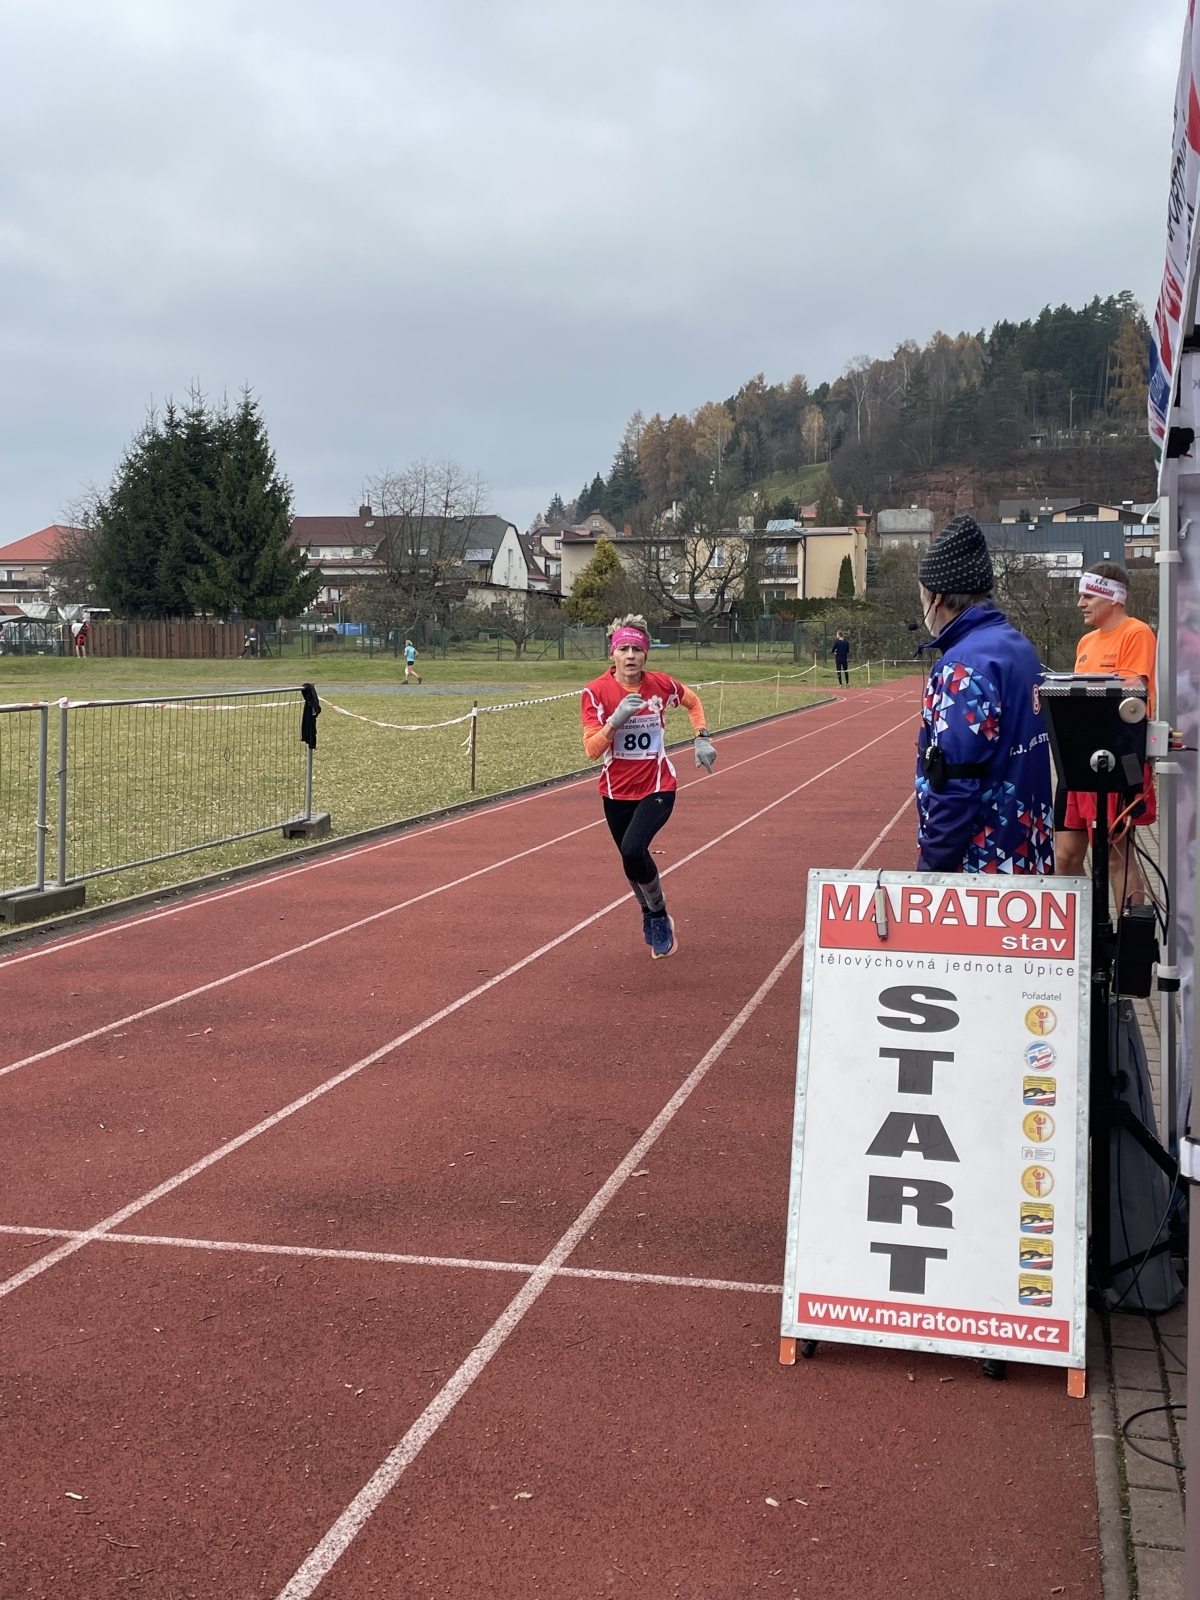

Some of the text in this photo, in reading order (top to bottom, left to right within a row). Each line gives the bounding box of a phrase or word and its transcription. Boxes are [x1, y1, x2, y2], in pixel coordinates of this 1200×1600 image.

[624, 733, 651, 750] 80
[822, 884, 1076, 931] MARATON
[1001, 933, 1067, 952] stav
[820, 954, 1075, 978] tělovýchovná jednota Úpice
[1021, 991, 1062, 1001] Pořadatel
[865, 985, 961, 1296] START
[807, 1301, 1060, 1344] www.maratonstav.cz
